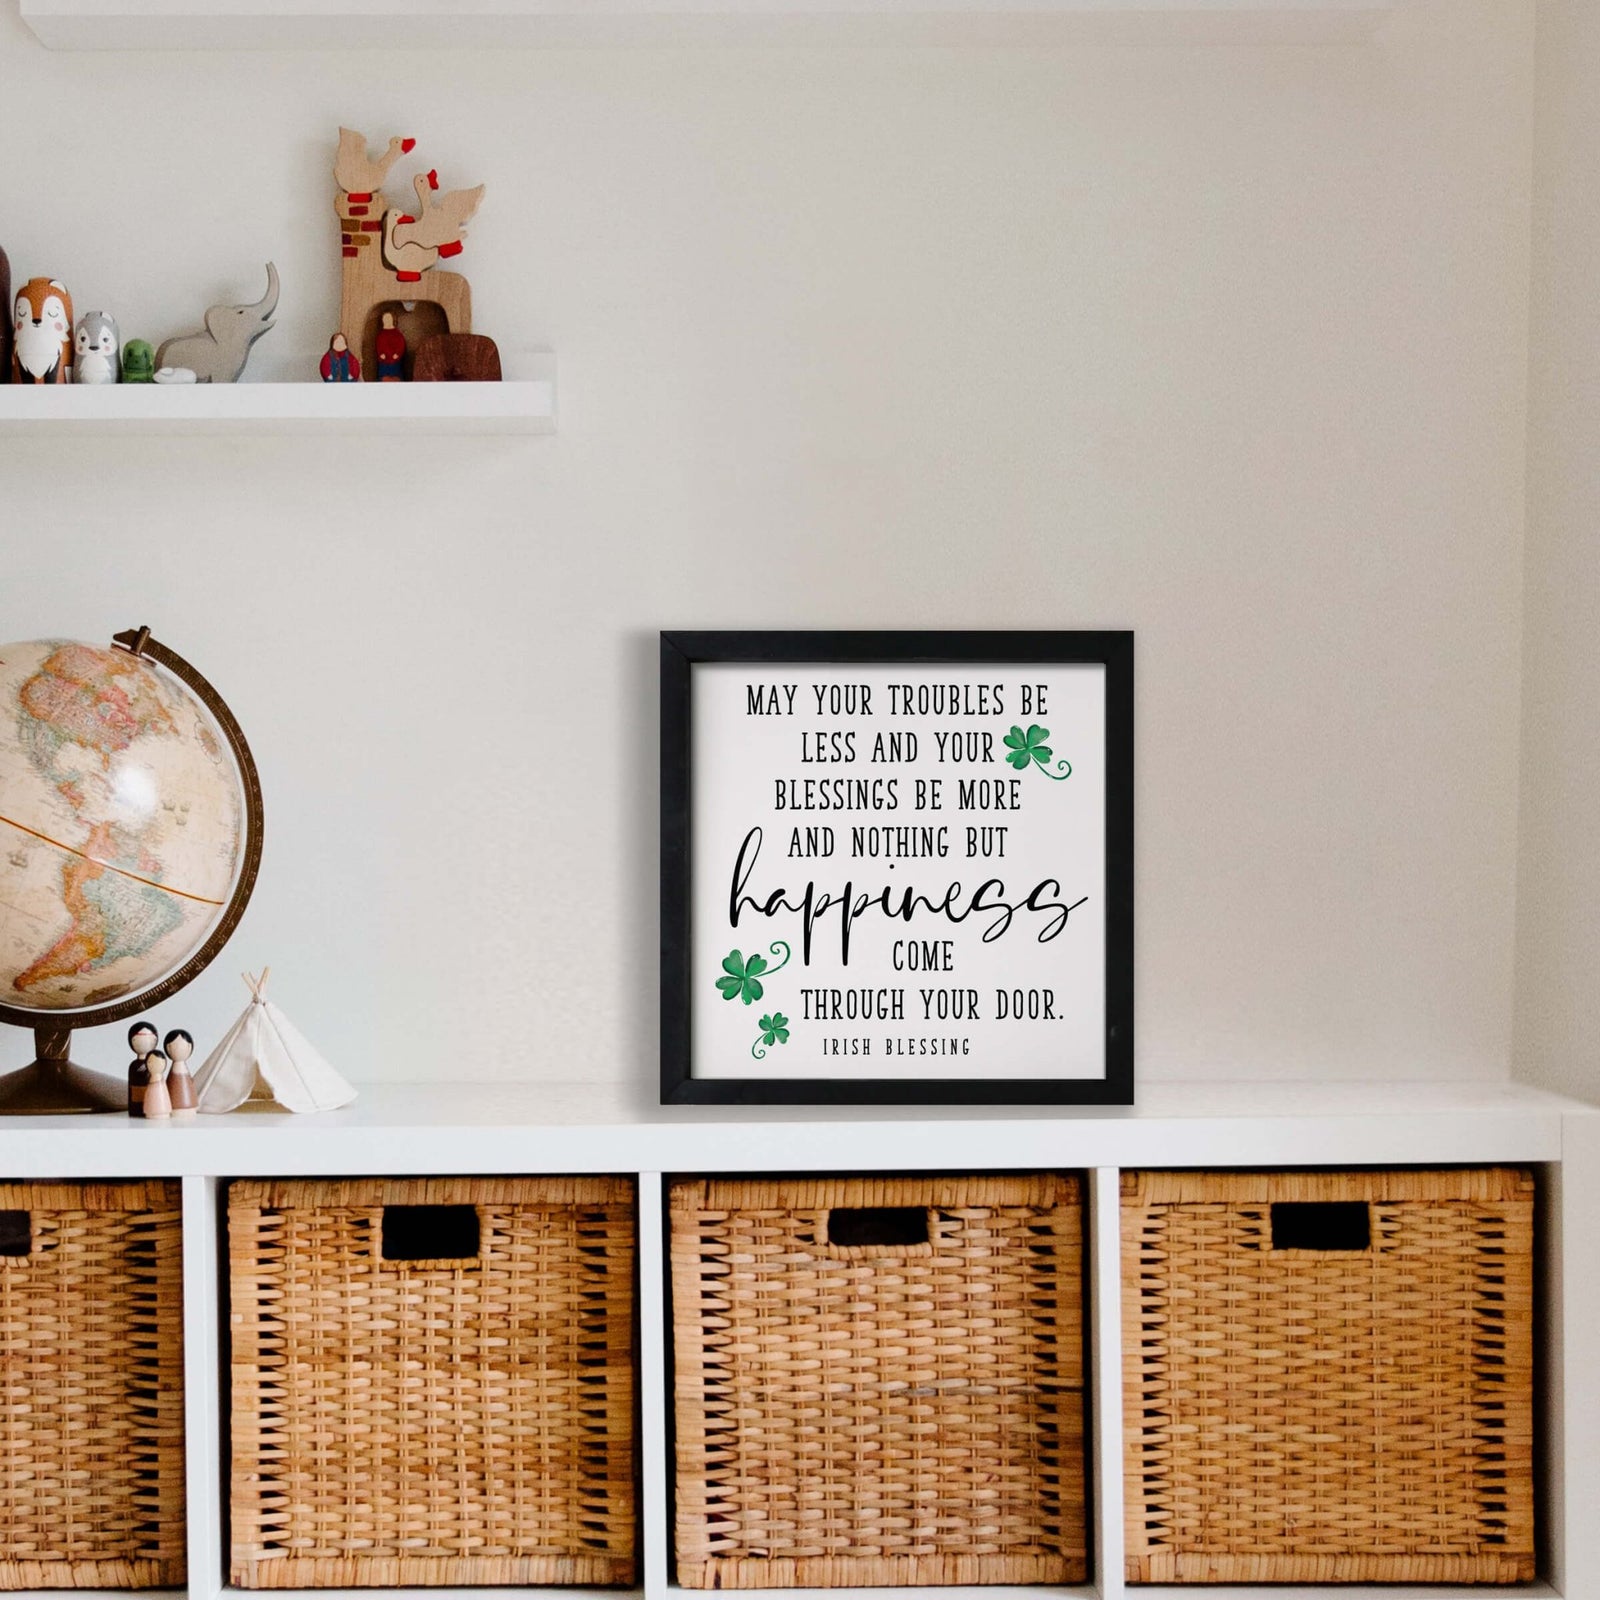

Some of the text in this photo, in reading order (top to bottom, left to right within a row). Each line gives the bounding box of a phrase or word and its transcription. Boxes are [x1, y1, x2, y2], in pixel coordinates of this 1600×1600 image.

[747, 684, 1047, 715] MAY YOUR TROUBLES BE
[802, 732, 994, 762] LESS AND YOUR
[775, 779, 1020, 810] BLESSINGS BE MORE
[788, 826, 1007, 857] AND NOTHING BUT
[730, 827, 1088, 966] happiness
[893, 940, 953, 971] COME
[801, 989, 1063, 1019] THROUGH YOUR DOOR.
[824, 1039, 969, 1055] IRISH BLESSING
